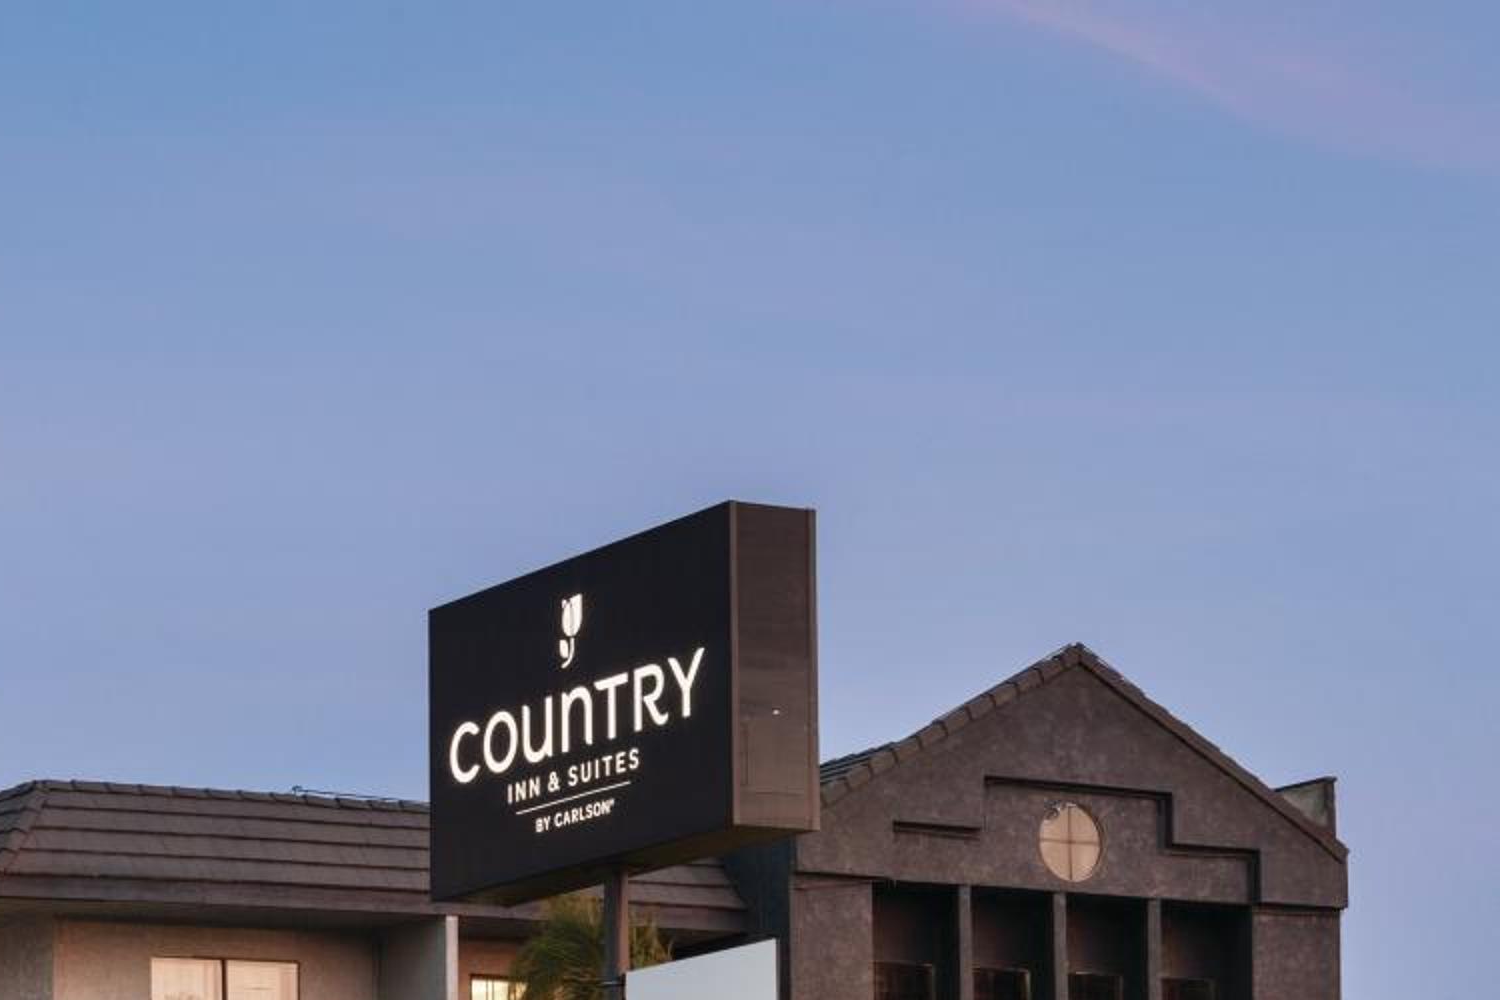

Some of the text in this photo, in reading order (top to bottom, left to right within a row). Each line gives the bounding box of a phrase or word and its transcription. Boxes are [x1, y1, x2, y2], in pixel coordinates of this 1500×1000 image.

[507, 748, 640, 804] INN & SUITES
[535, 815, 551, 833] BY
